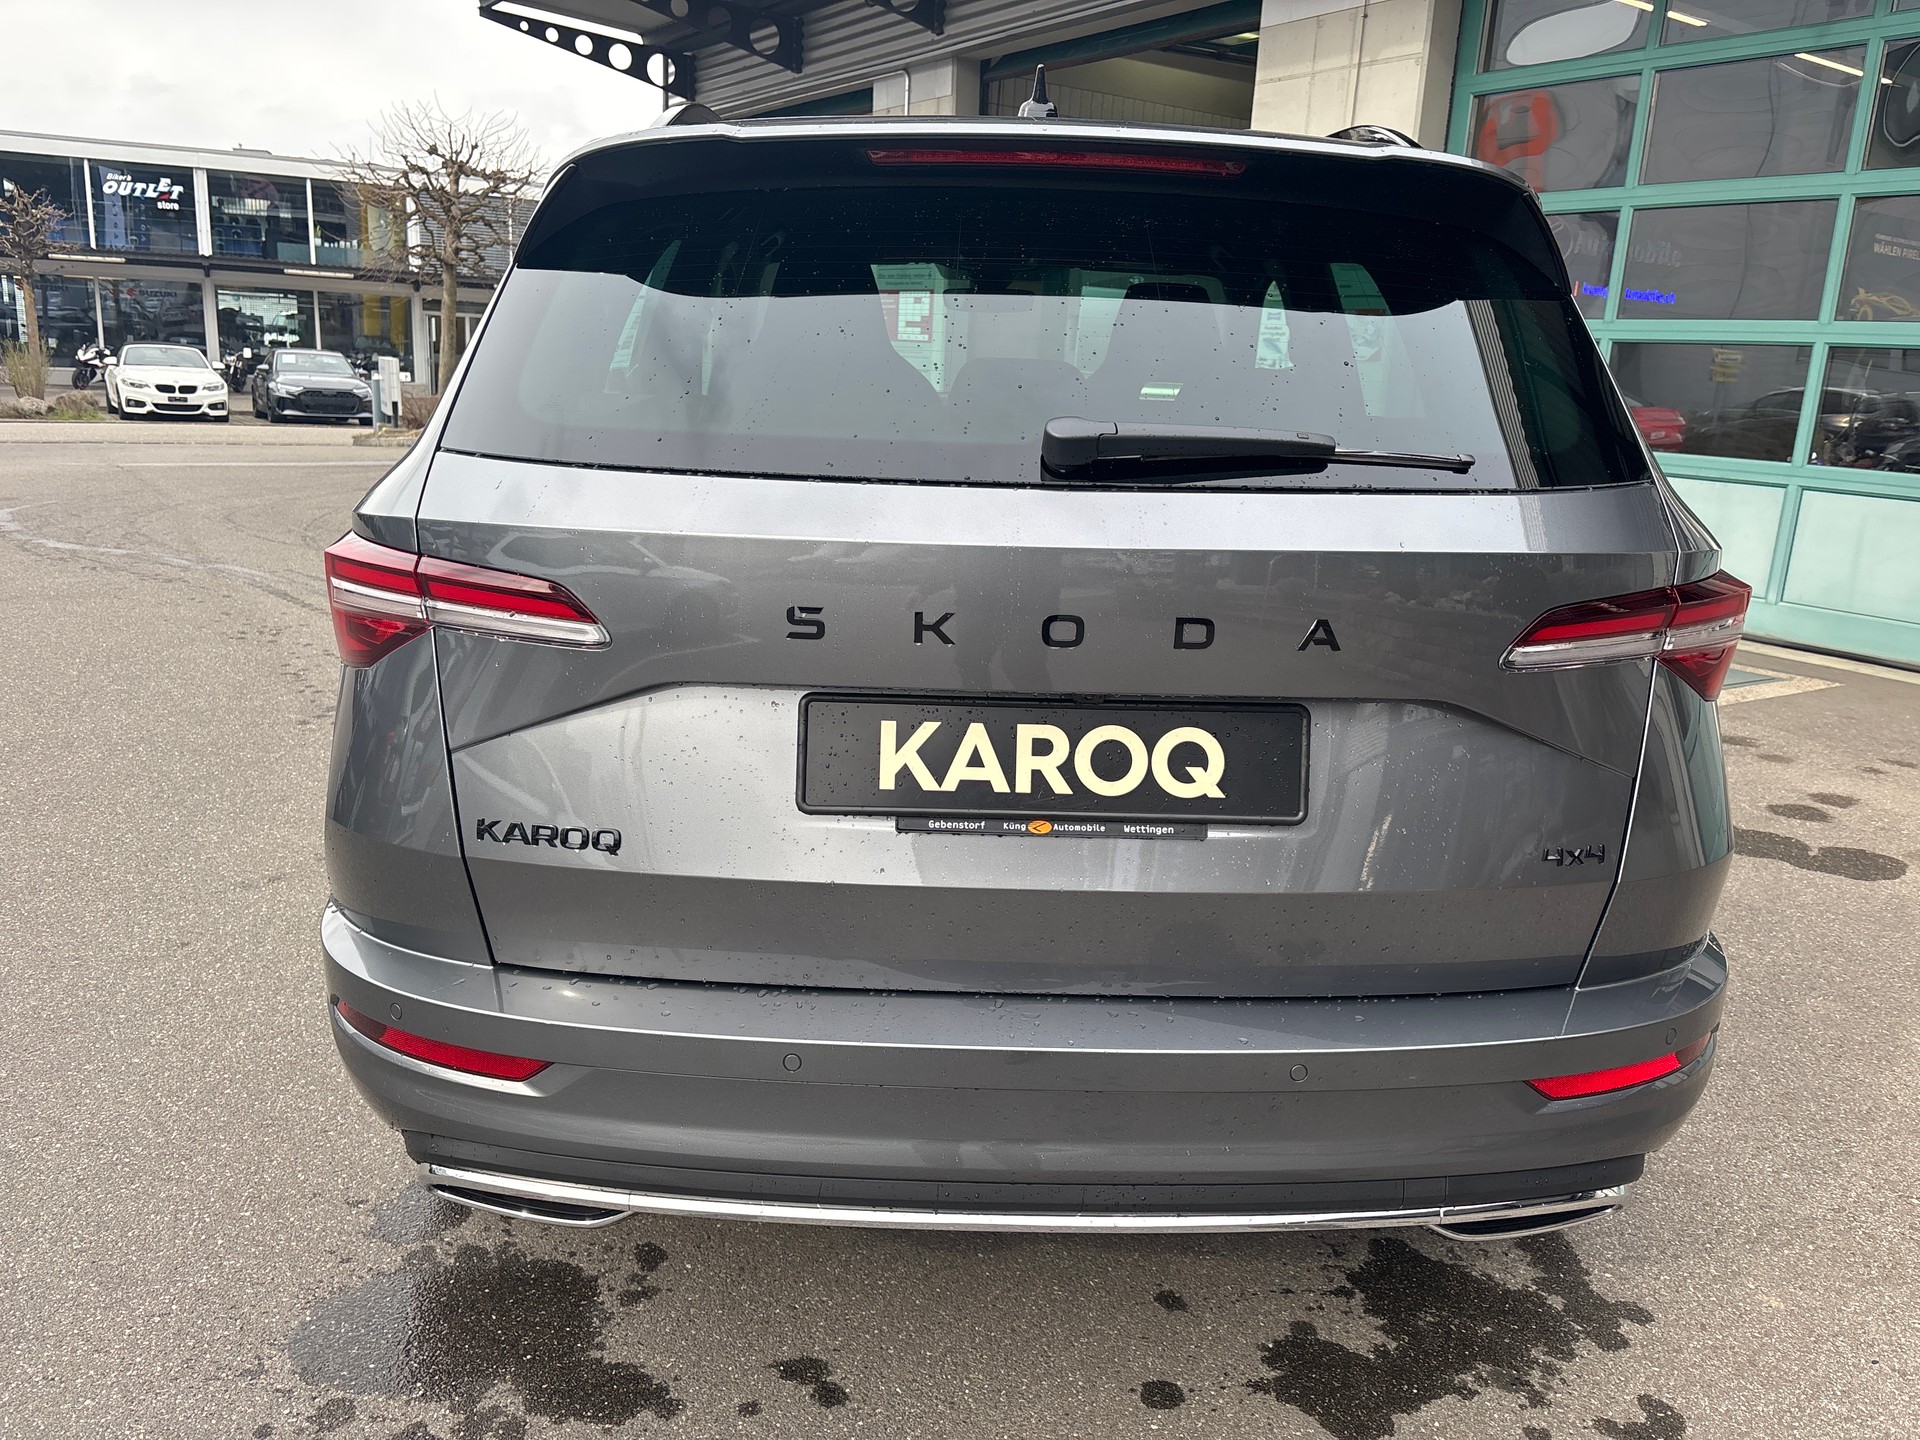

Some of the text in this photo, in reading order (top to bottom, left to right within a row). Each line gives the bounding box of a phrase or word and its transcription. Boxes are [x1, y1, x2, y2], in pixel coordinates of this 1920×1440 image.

[102, 178, 184, 200] OUTLET
[157, 201, 180, 211] store
[785, 606, 1342, 652] SKODA
[878, 719, 1226, 799] KAROQ
[476, 818, 622, 856] KAROQ
[928, 820, 1176, 835] Gebenstorf Küng Automobile Wettingen
